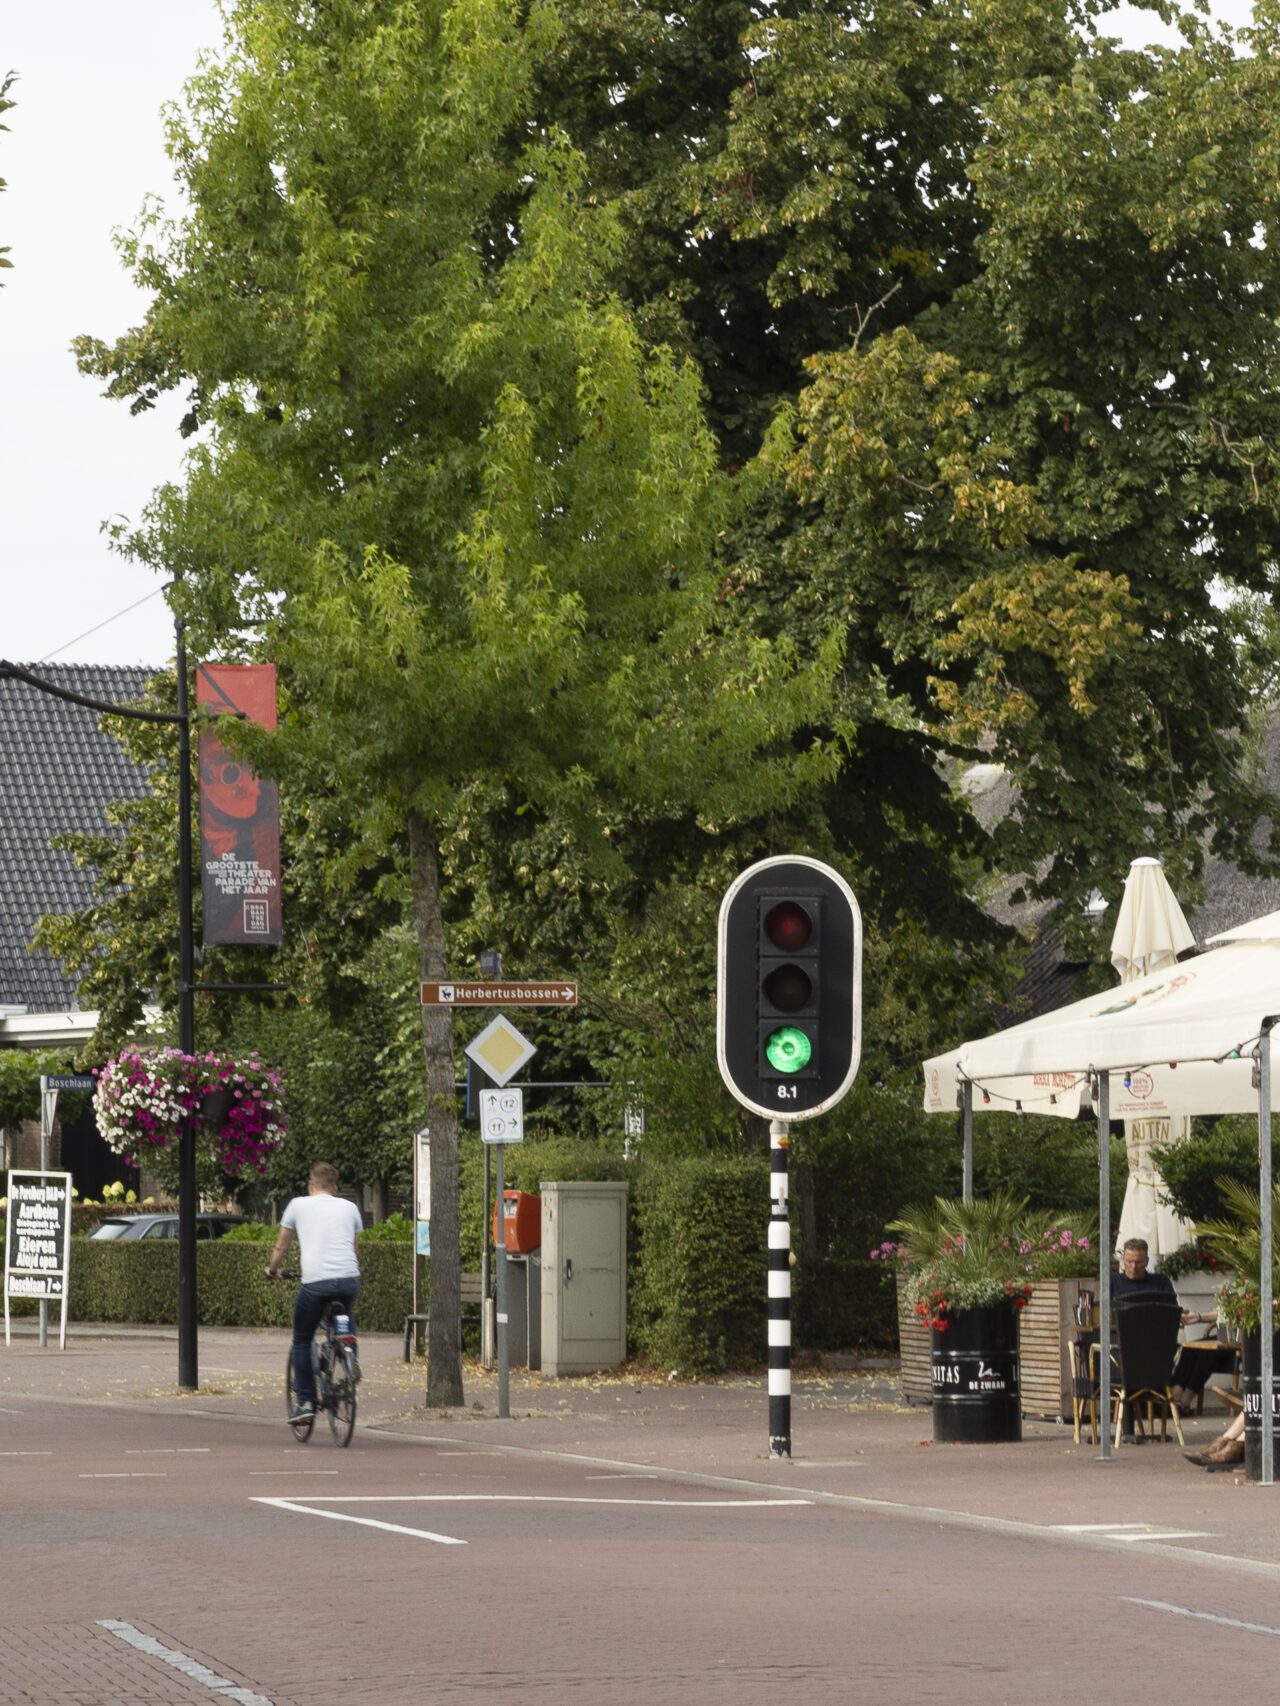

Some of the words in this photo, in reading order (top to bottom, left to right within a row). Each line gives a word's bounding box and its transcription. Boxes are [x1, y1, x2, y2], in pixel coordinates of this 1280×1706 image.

[222, 852, 236, 861] DE
[205, 861, 259, 870] GROOTSTE
[227, 869, 272, 878] THEATER
[215, 877, 255, 887] PARADE
[257, 878, 277, 887] VAN
[221, 886, 241, 894] HET
[243, 886, 268, 895] JAAR
[456, 985, 559, 999] Herbertusbossen
[49, 1077, 92, 1088] Boschlaan
[778, 1085, 797, 1098] 8.1
[503, 1099, 515, 1108] 12
[492, 1122, 501, 1131] 11
[19, 1236, 56, 1254] Eieren
[39, 1256, 58, 1271] open
[9, 1276, 46, 1293] Boschlaan
[969, 1381, 979, 1390] DE
[980, 1381, 1005, 1390] ZWAAN
